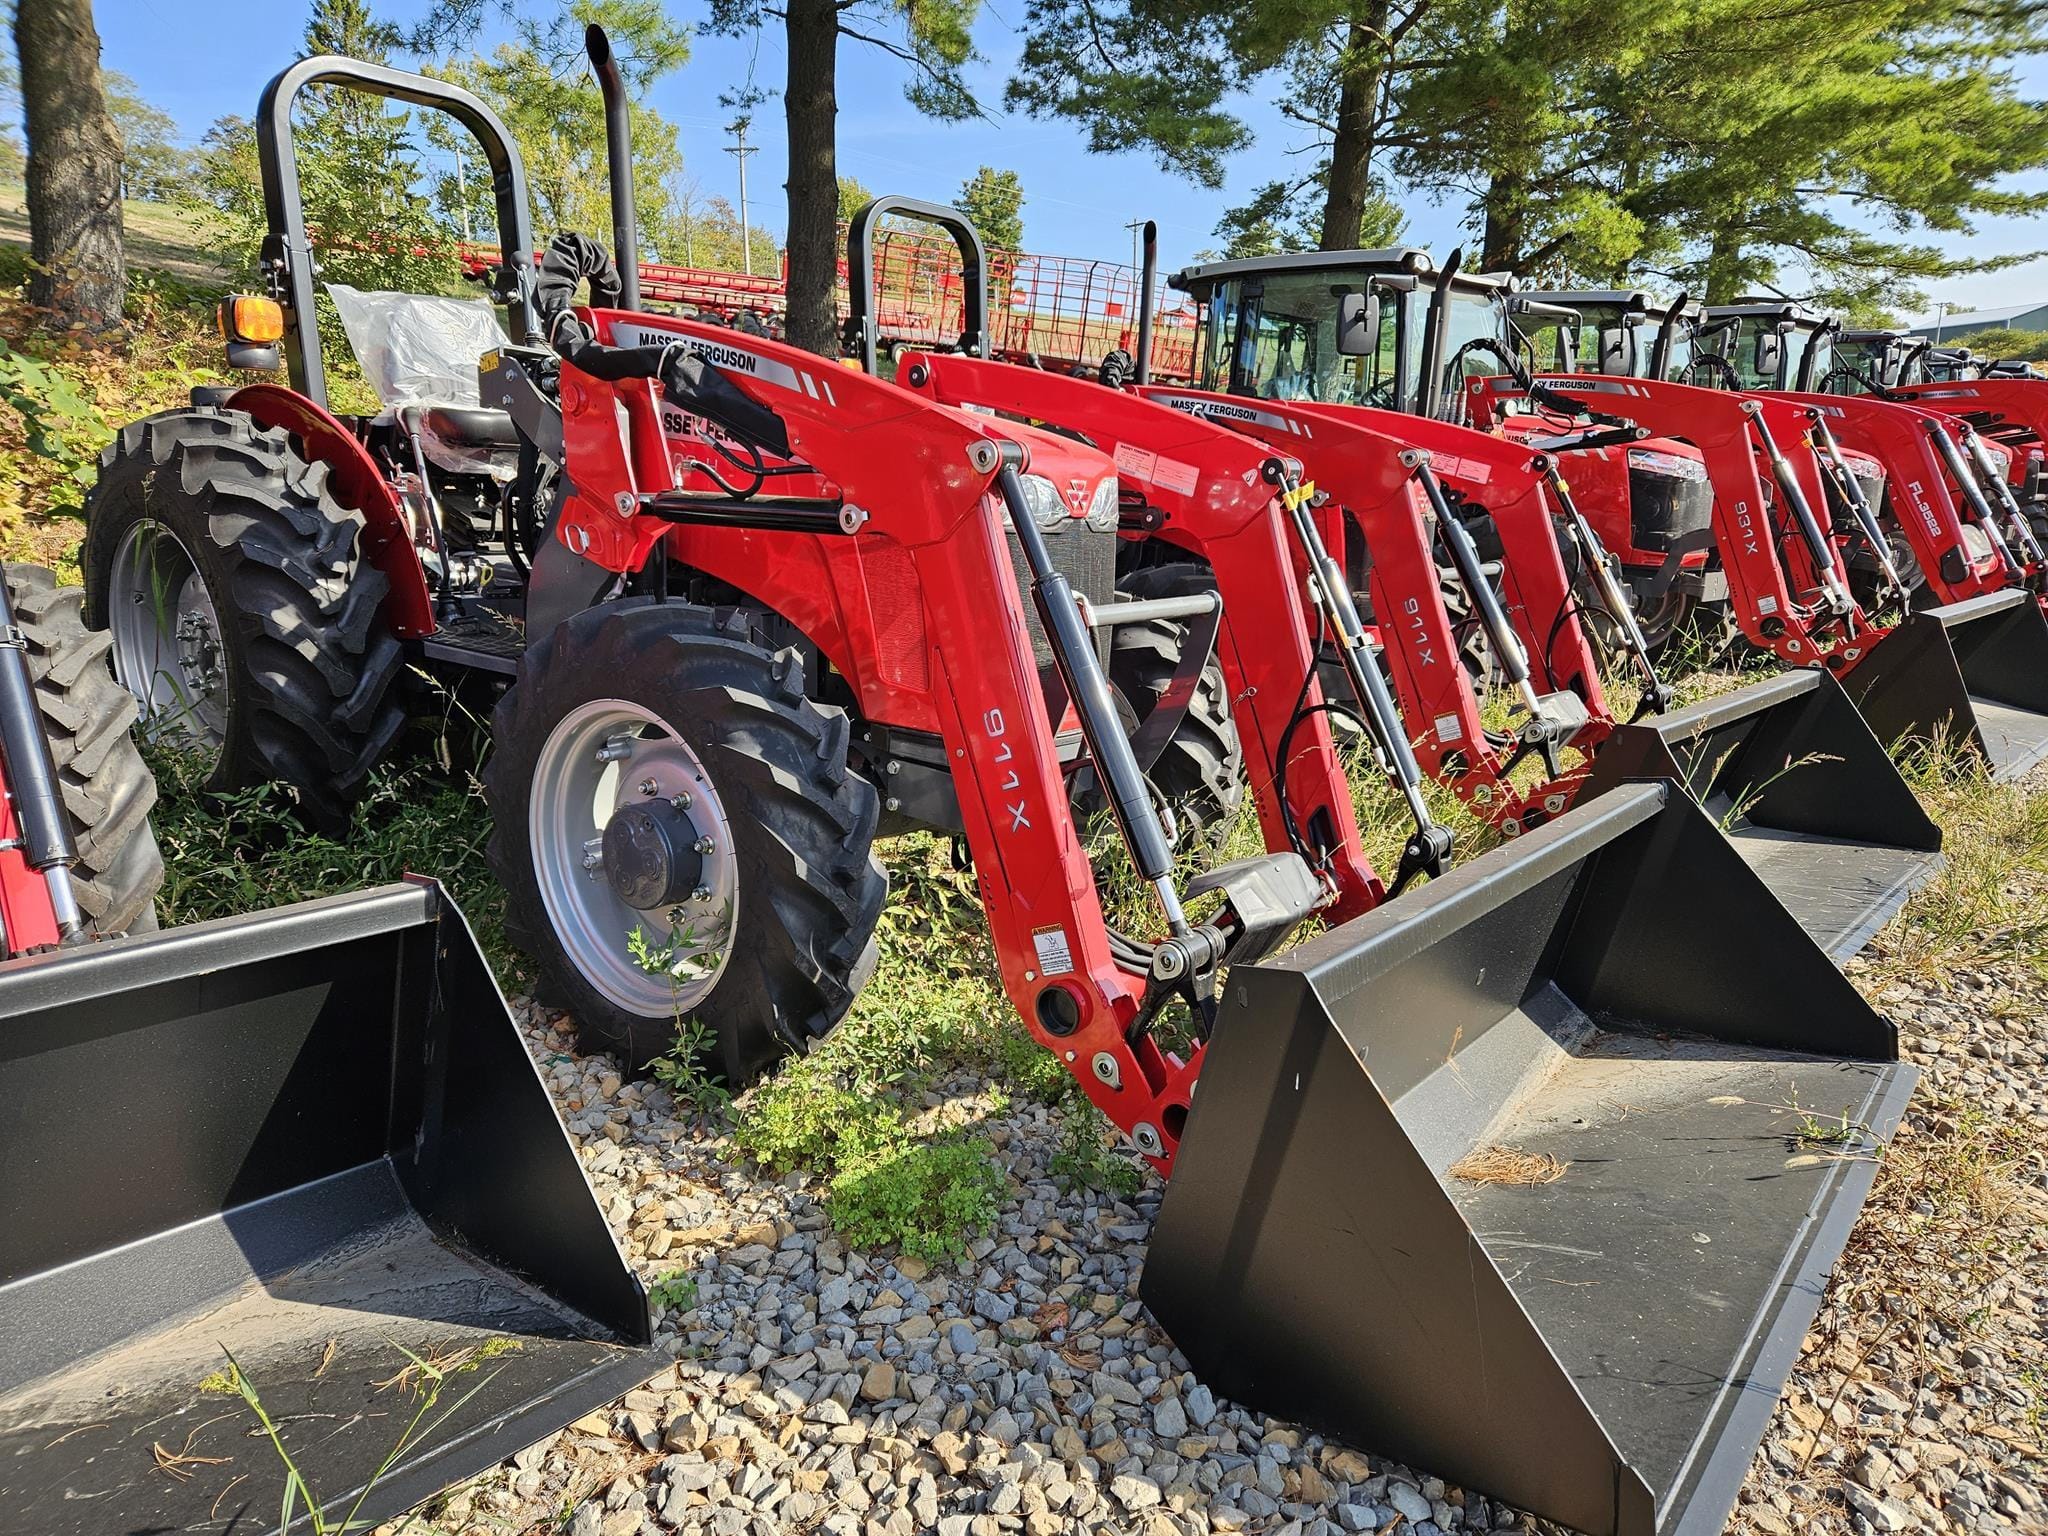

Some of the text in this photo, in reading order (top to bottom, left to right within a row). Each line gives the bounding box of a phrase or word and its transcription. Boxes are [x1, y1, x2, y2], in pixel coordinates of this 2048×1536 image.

[1208, 404, 1258, 421] FERGUSON
[1549, 381, 1597, 390] FERGUSON
[1735, 501, 1758, 556] 931X
[1404, 597, 1435, 667] 911X
[983, 708, 1031, 833] 911X
